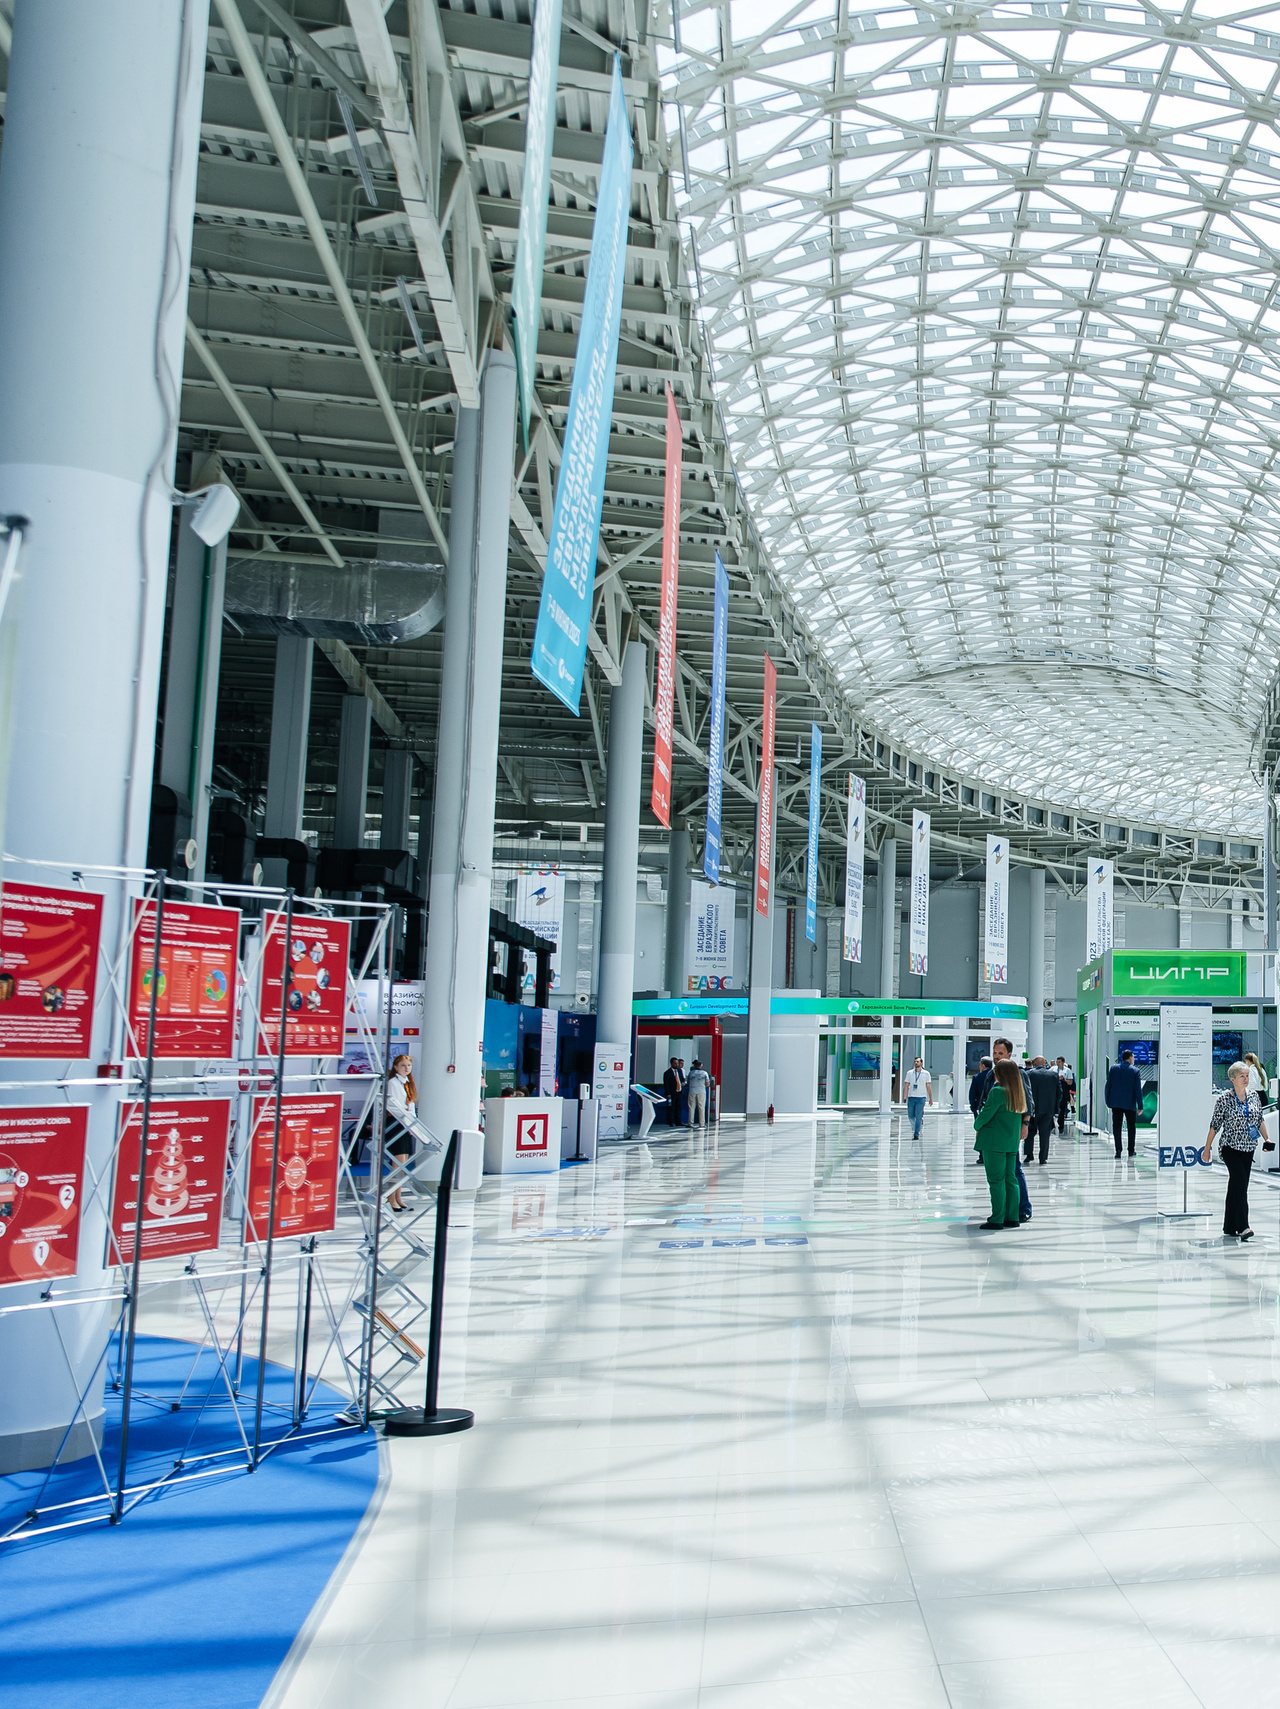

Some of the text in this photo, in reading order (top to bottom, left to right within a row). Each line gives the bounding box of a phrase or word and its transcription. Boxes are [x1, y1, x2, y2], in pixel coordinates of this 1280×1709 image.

[569, 188, 623, 591] МЕЖПРАВИТЕЛЬСТВЕННОГО
[561, 348, 600, 580] ЕВРАЗИЙСКОГО
[553, 388, 586, 570] ЗАСЕДАНИЕ
[577, 495, 597, 600] СОВЕТА
[697, 916, 705, 953] ЗАСЕДАНИЕ
[705, 904, 714, 953] ЕВРАЗИЙСКОГО
[719, 929, 727, 954] СОВЕТА
[688, 975, 733, 991] ЕАЭС
[984, 963, 1007, 982] ЕАЭС
[1130, 966, 1230, 980] ЦИПР
[708, 1003, 736, 1011] Development
[862, 1003, 893, 1011] Евразийский
[1160, 1146, 1212, 1167] ЕАЭС
[64, 1189, 71, 1201] 2
[39, 1246, 44, 1258] 1
